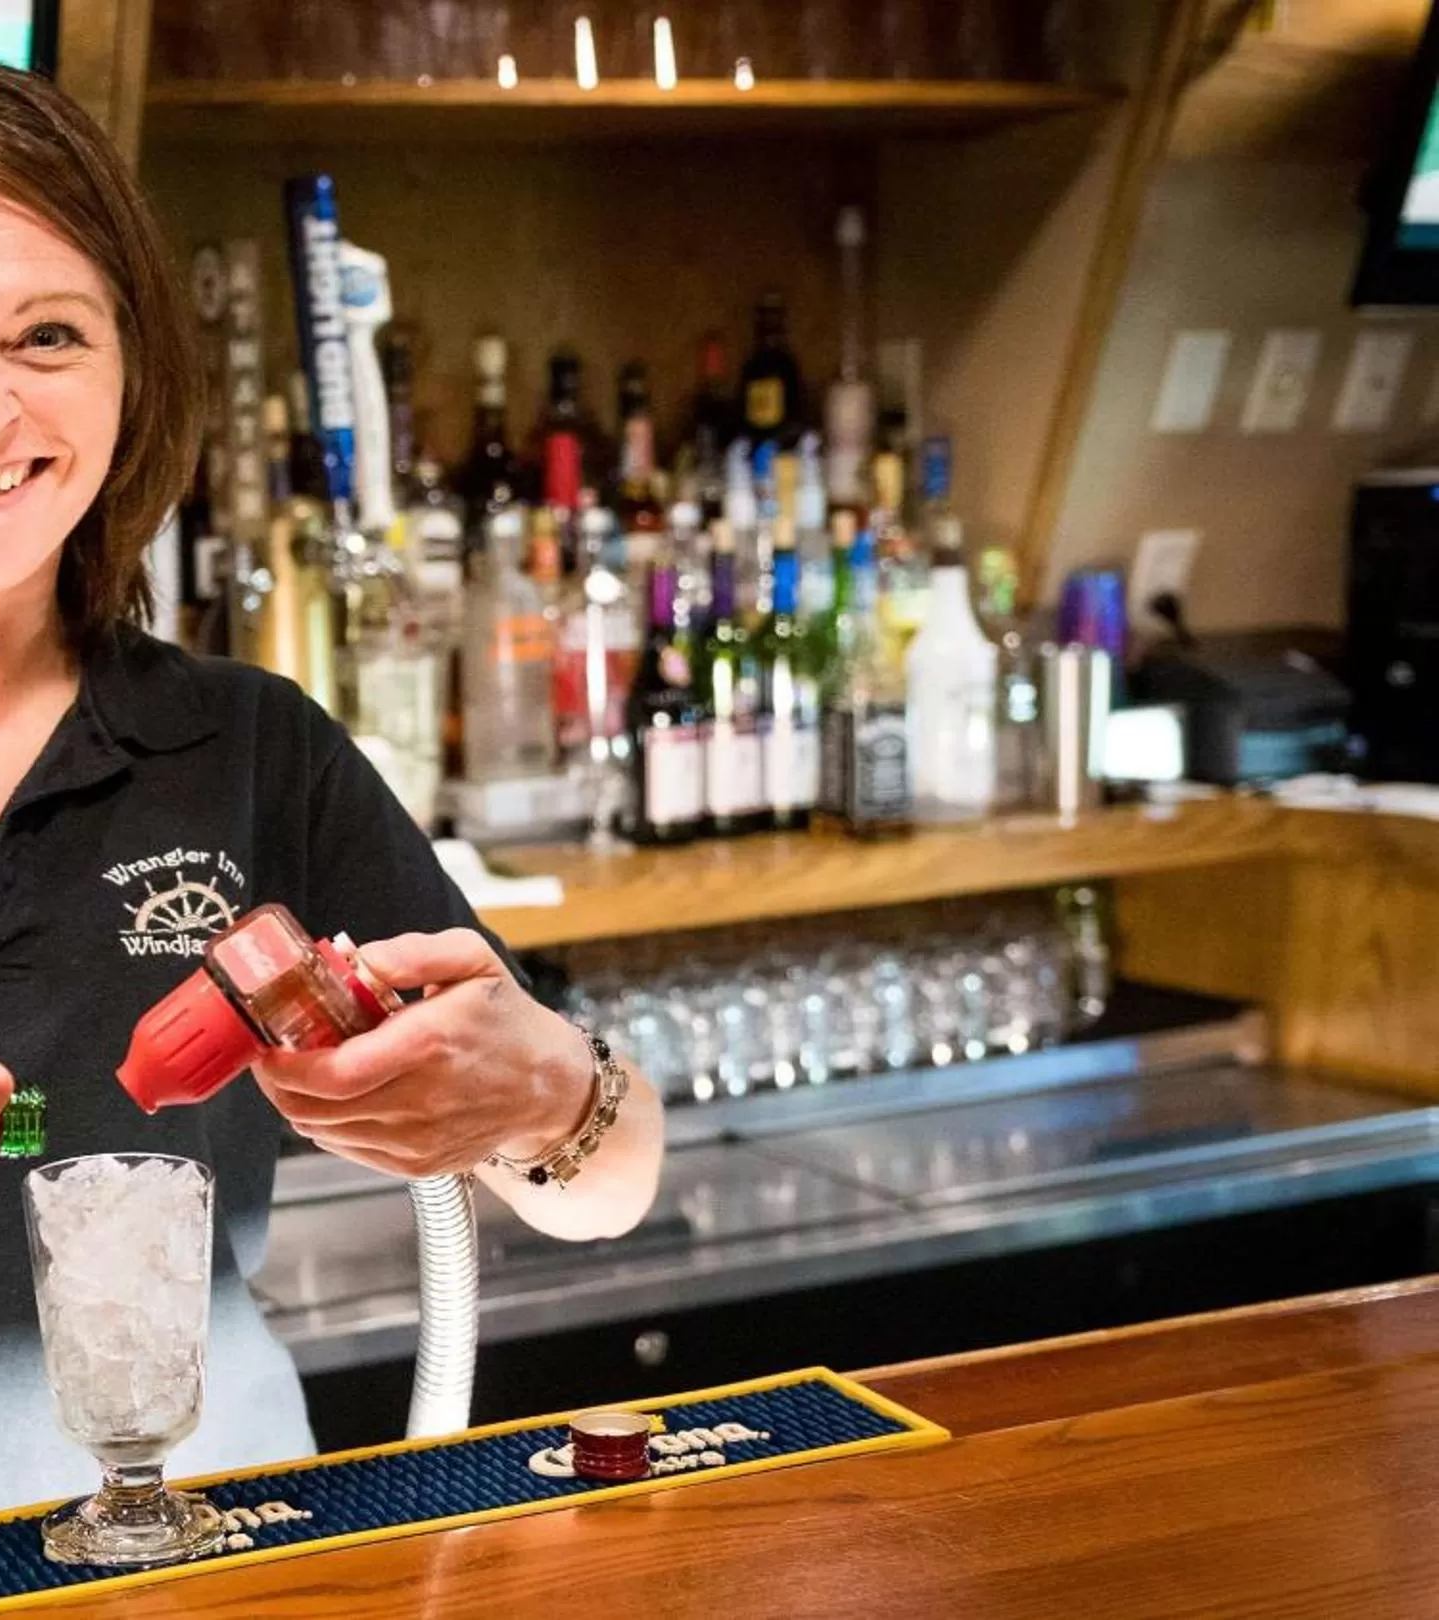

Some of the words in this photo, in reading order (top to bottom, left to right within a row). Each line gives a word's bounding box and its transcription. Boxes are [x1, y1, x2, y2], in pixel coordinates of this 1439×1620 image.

[315, 341, 356, 430] BUD
[101, 848, 211, 887] Wrangler
[217, 851, 247, 889] Inn
[120, 934, 204, 959] Windja
[528, 1422, 770, 1478] Cona.
